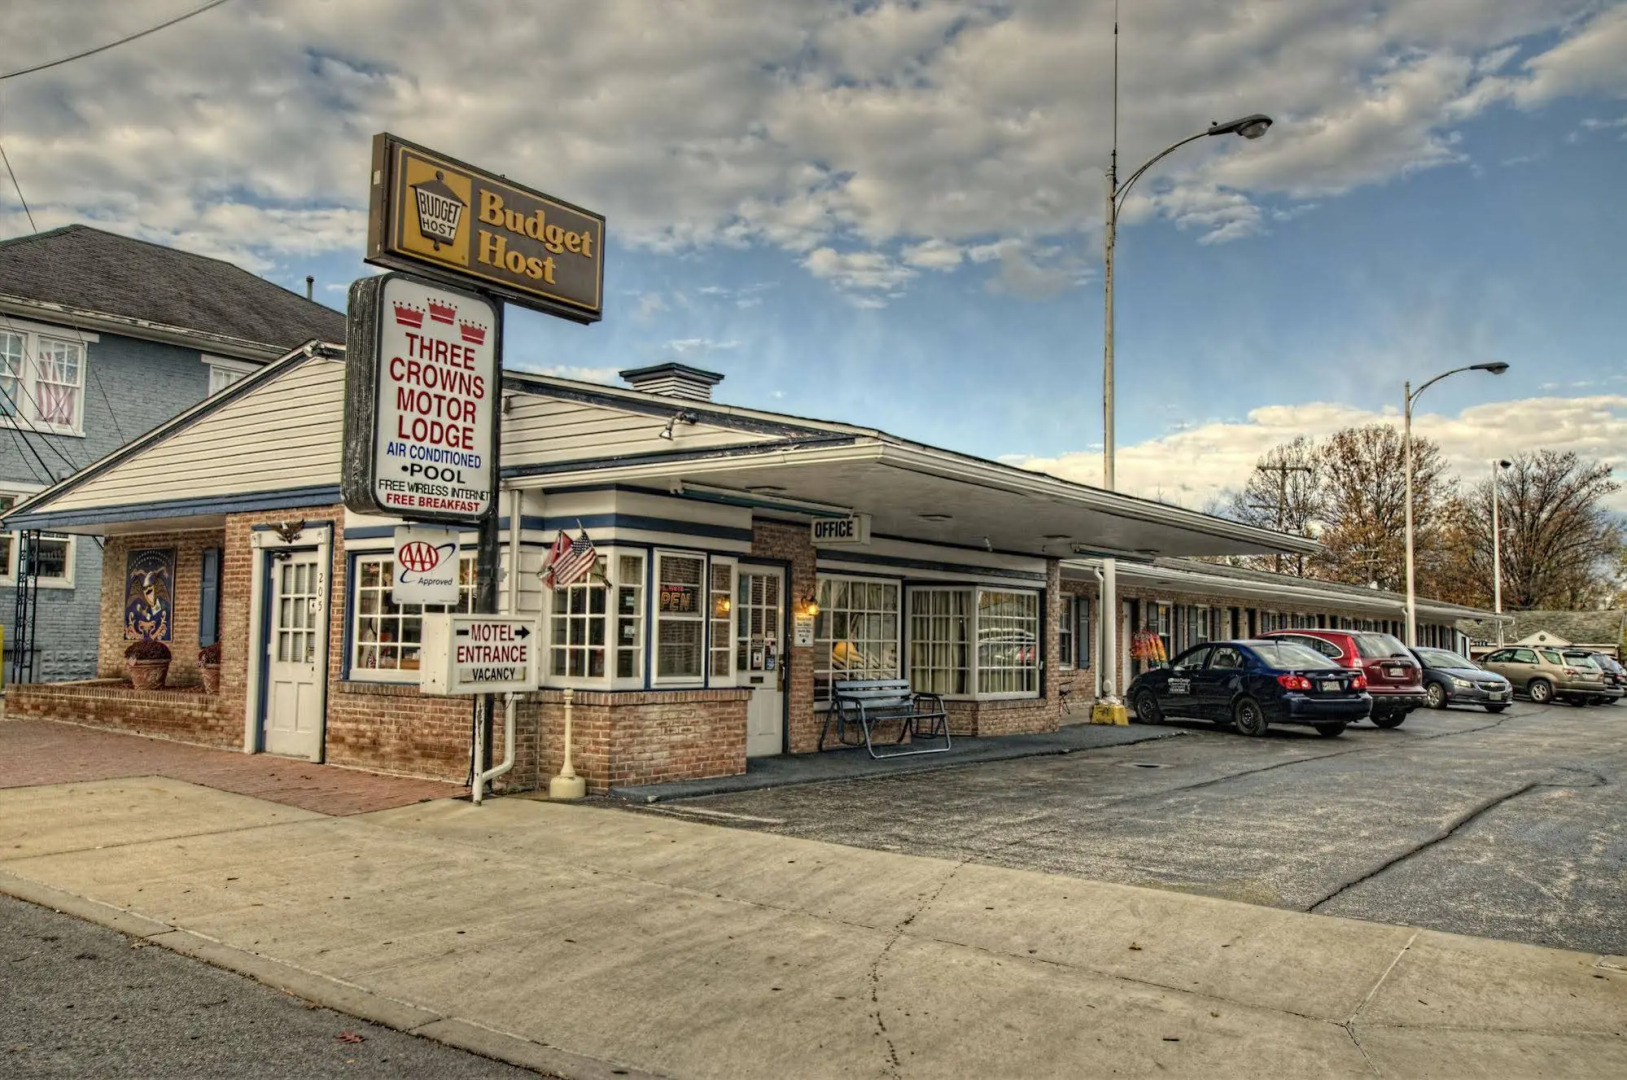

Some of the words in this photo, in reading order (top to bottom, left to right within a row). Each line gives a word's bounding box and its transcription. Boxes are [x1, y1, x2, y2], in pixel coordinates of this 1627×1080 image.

[418, 191, 460, 224] BUDGET
[422, 217, 455, 236] HOST
[479, 188, 593, 258] Budget
[477, 229, 556, 285] Host
[405, 332, 476, 371] THREE
[390, 356, 485, 399] CROWNS
[397, 386, 477, 424] MOTOR
[398, 415, 474, 450] LODGE
[386, 441, 406, 457] AIR
[409, 444, 481, 469] CONDITIONED
[378, 478, 406, 492] FREE
[407, 482, 449, 497] WIRELESS
[451, 488, 491, 502] INTERNET
[386, 493, 415, 506] FREE
[418, 496, 480, 512] BREAKFAST
[814, 520, 853, 538] OFFICE
[402, 542, 437, 571] AAA
[418, 576, 453, 586] Approved
[660, 591, 690, 611] PEN
[471, 624, 515, 642] MOTEL
[457, 645, 527, 663] ENTRANCE
[472, 667, 516, 681] VACANCY
